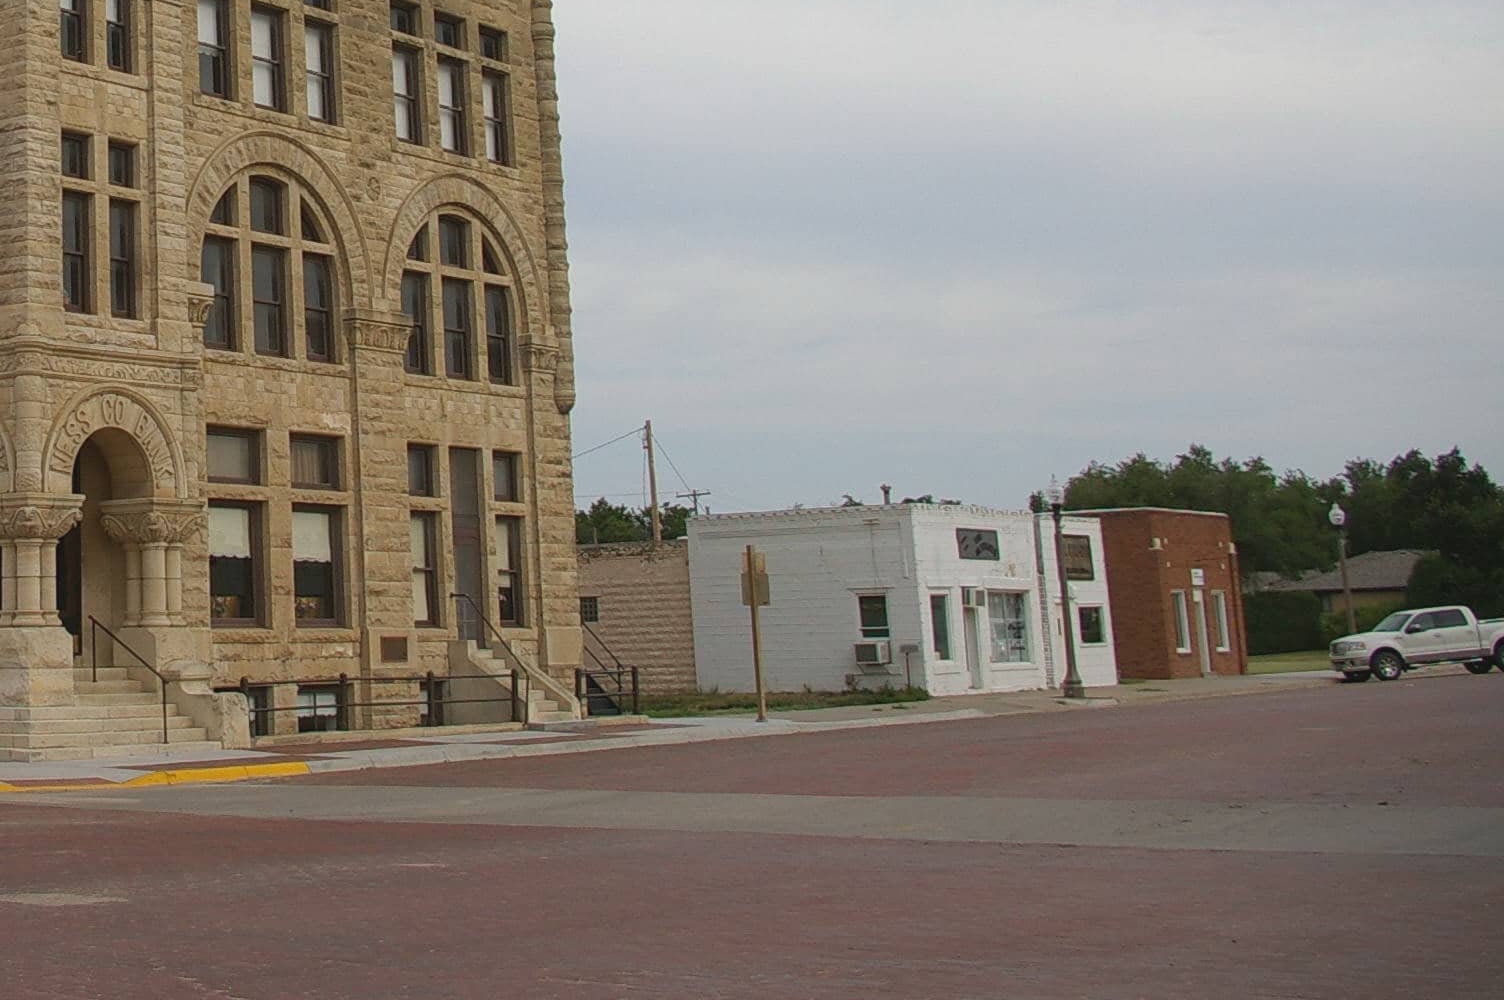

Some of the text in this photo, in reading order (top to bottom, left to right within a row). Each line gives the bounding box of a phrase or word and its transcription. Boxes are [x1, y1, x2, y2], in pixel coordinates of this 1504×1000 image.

[48, 409, 90, 475] NESS
[100, 399, 125, 426] CO
[133, 410, 176, 479] BANK
